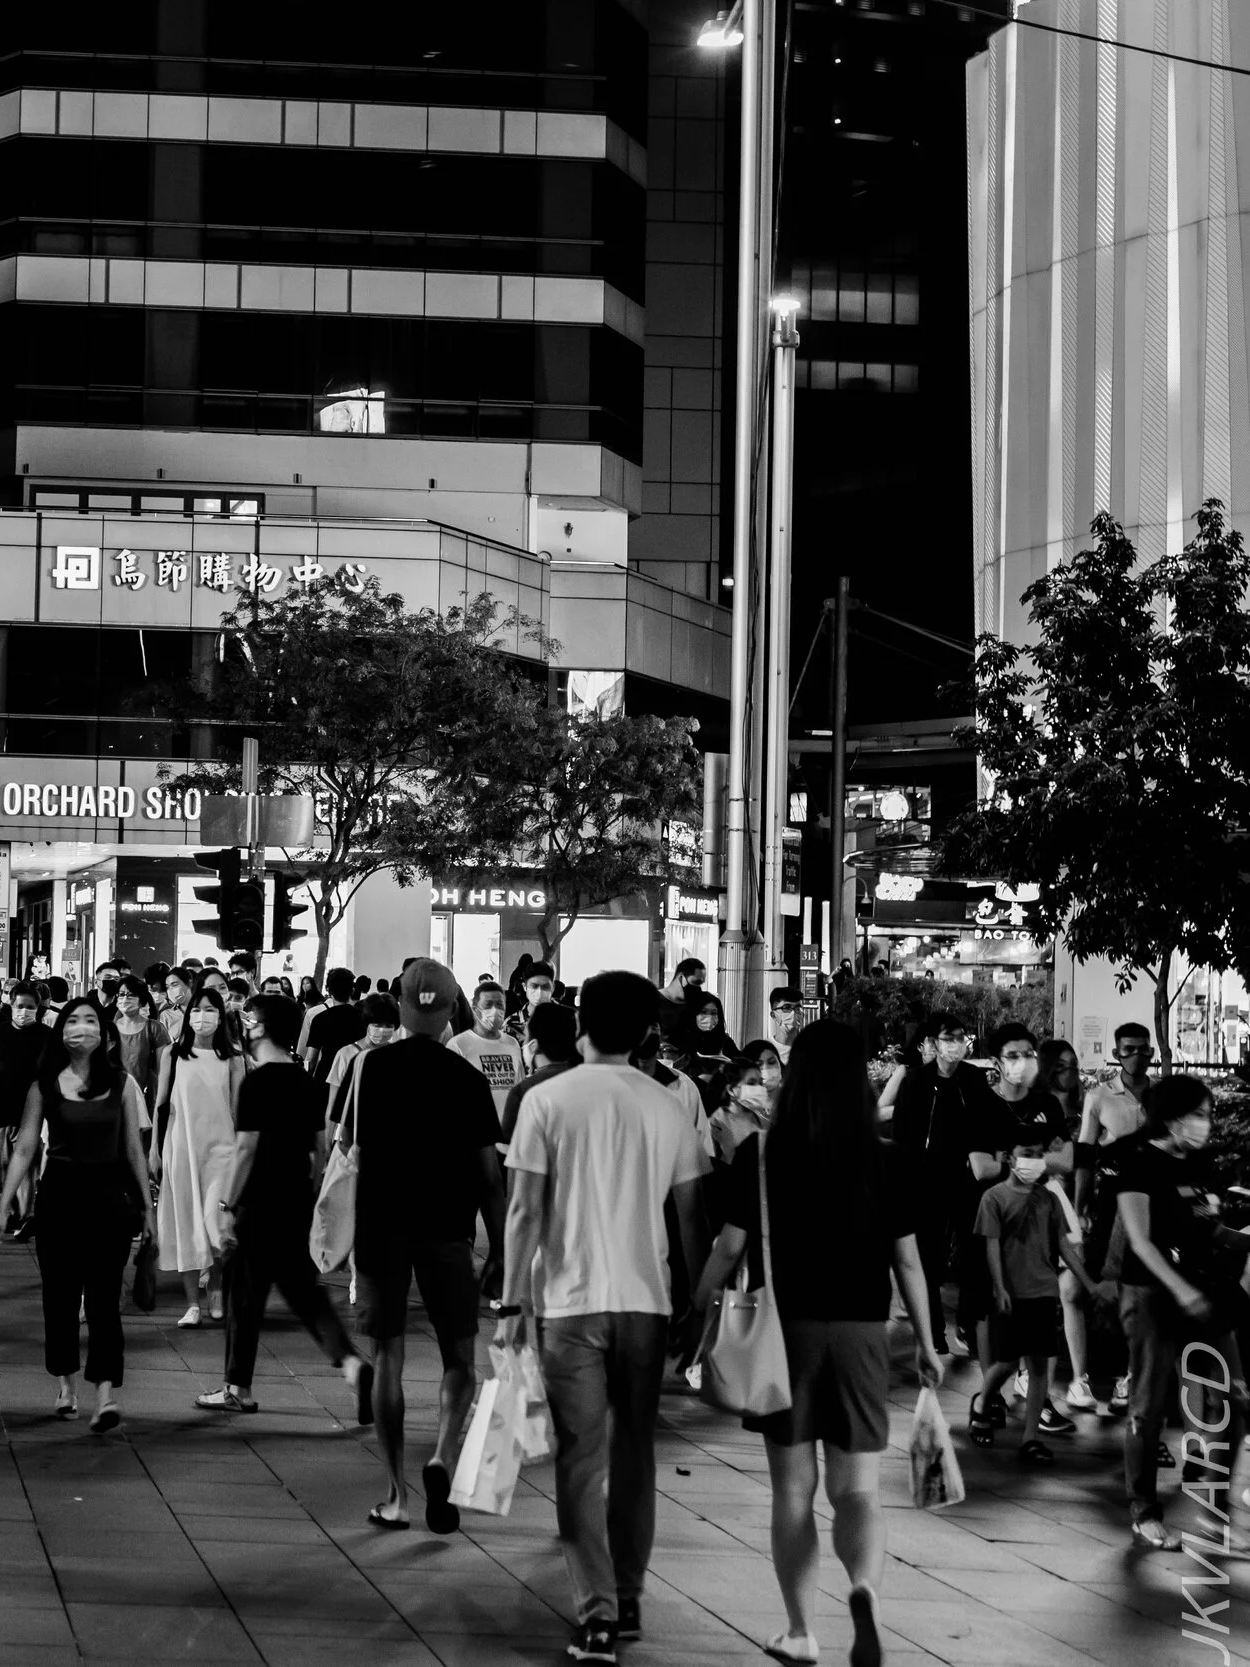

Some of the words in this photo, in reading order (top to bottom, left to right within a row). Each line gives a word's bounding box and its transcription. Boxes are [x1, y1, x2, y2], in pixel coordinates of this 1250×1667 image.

[3, 782, 135, 818] ORCHARD
[430, 887, 459, 905] OH
[469, 888, 546, 908] HENG
[974, 929, 1005, 941] BAO
[1011, 930, 1031, 941] TO
[801, 950, 817, 961] 313
[419, 992, 436, 1005] W
[480, 1055, 512, 1063] BRAVERY
[482, 1062, 515, 1073] NEVER
[488, 1078, 515, 1086] ASHION
